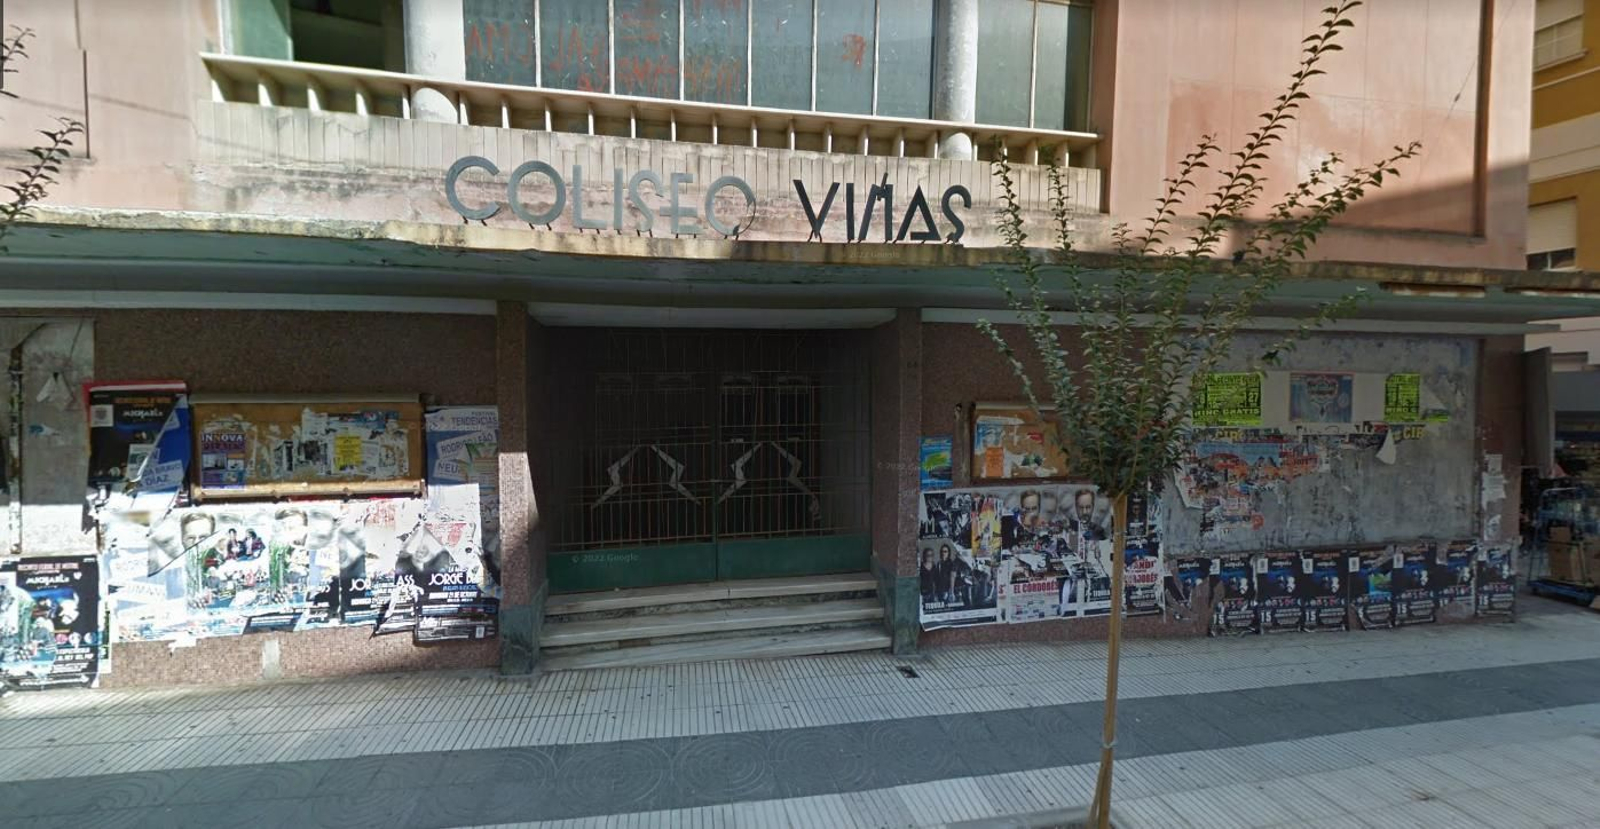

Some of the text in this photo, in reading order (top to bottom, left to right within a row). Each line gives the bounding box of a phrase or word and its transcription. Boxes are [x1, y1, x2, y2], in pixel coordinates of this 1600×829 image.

[445, 155, 757, 235] COLISEO
[429, 573, 463, 586] JORGE
[1013, 585, 1021, 594] EL
[1397, 603, 1407, 614] 15
[1260, 609, 1272, 622] 15
[1305, 609, 1316, 622] 15
